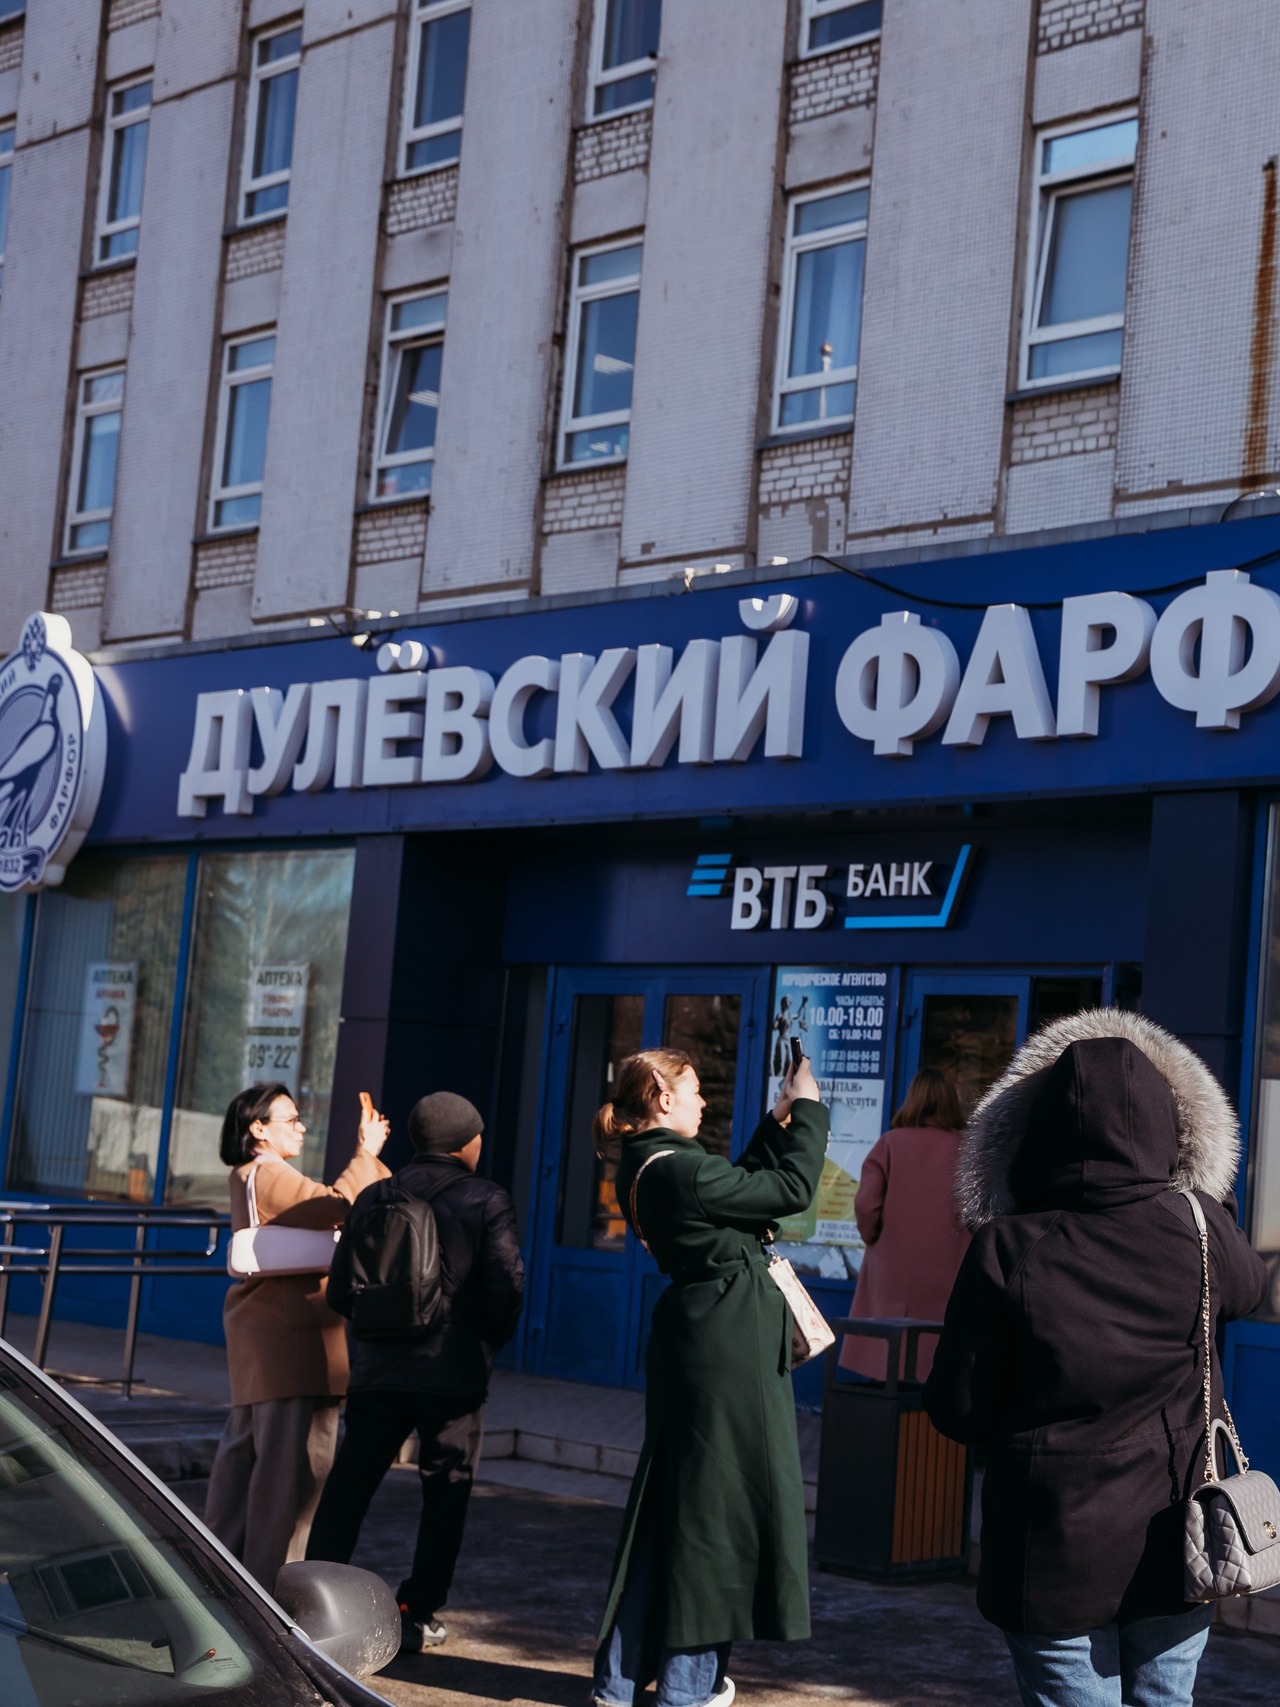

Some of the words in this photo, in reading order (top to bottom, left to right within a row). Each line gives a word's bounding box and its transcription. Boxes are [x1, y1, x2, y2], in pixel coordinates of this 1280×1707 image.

[177, 593, 810, 818] ДУЛЁВСКИЙ
[48, 731, 79, 831] ФАРФОР
[731, 864, 835, 930] ВТБ
[846, 861, 935, 897] БАНК
[257, 971, 303, 986] АПТЕКА
[841, 972, 887, 987] АГЕНТСТВО
[809, 1006, 884, 1027] 10.00-19.00
